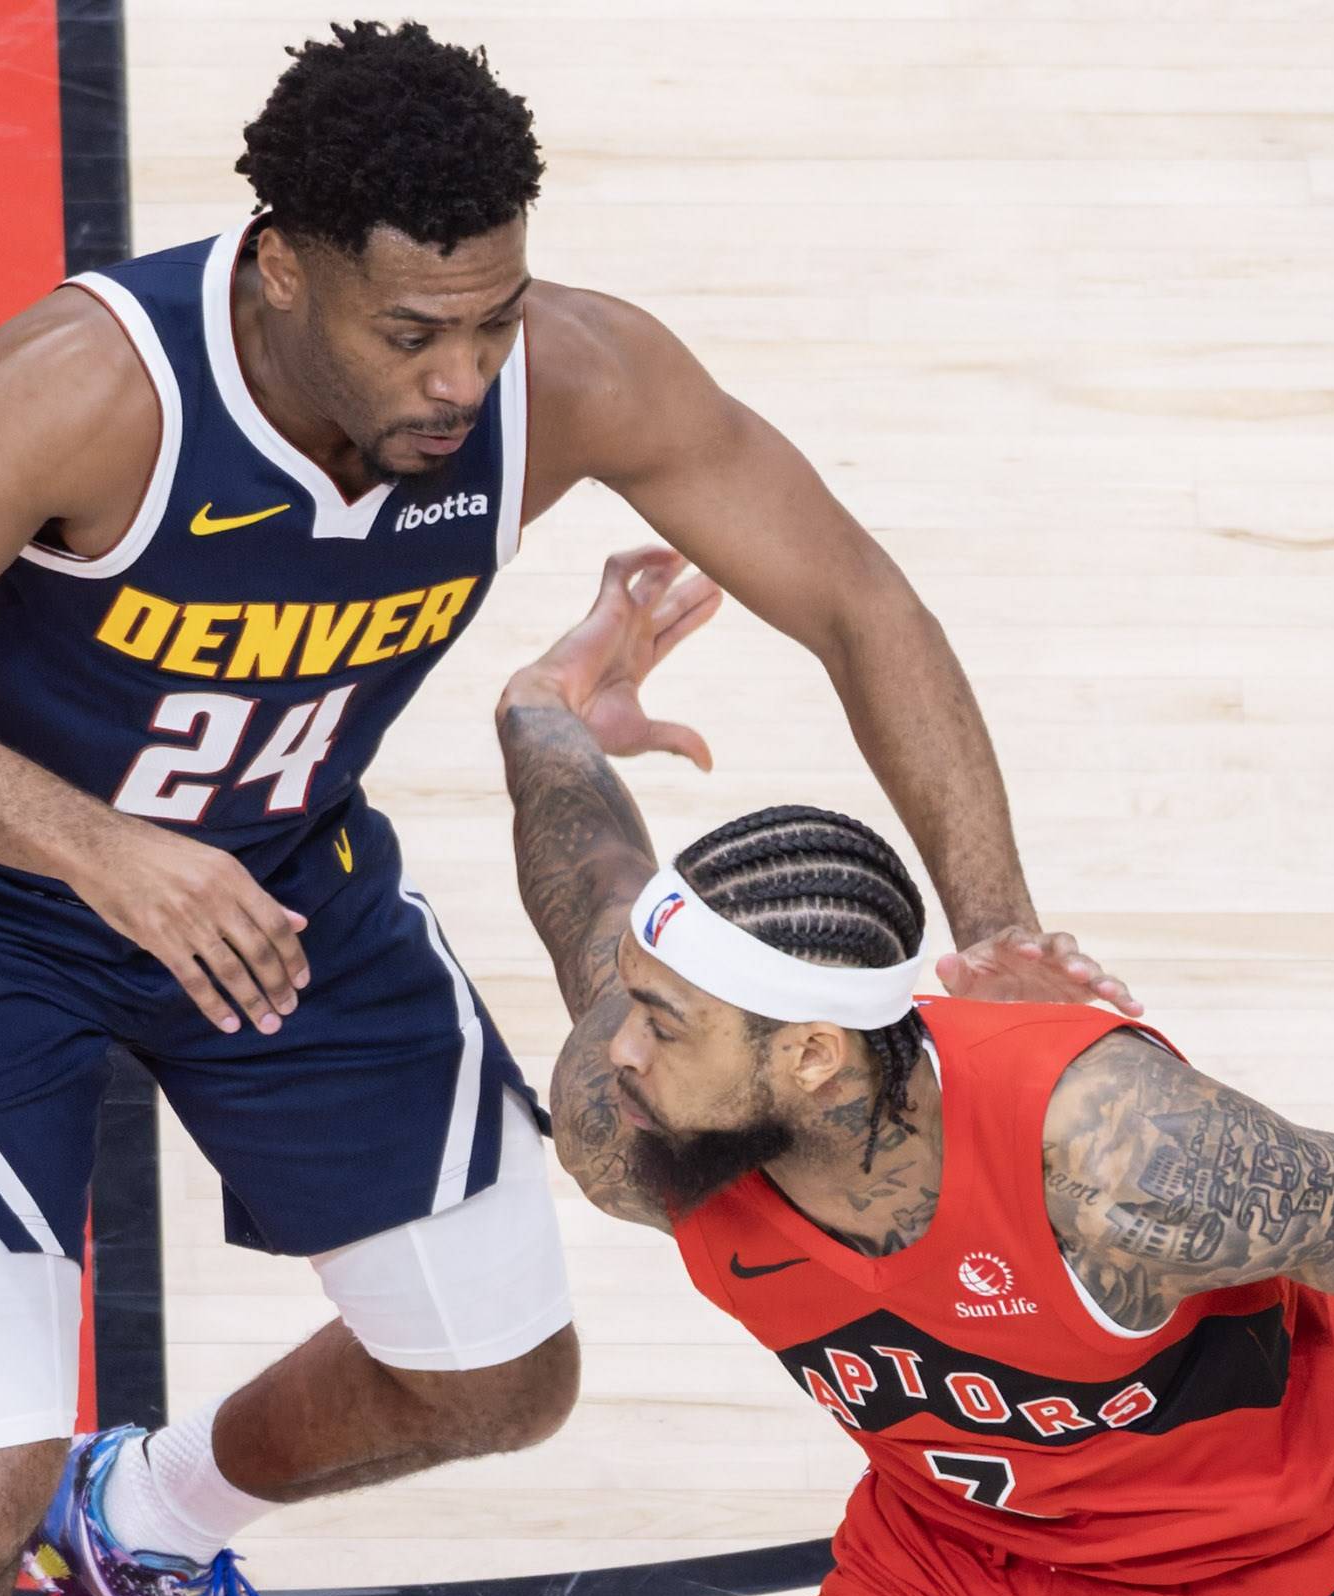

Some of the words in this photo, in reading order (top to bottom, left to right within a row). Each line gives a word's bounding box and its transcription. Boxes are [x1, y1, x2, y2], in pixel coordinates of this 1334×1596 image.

[395, 492, 488, 533] ibotta
[94, 576, 480, 681] DENVER
[112, 683, 357, 824] 24
[954, 1301, 997, 1319] Sun
[997, 1297, 1039, 1315] Life
[801, 1345, 1157, 1438] APTORS
[923, 1450, 1016, 1510] 7
